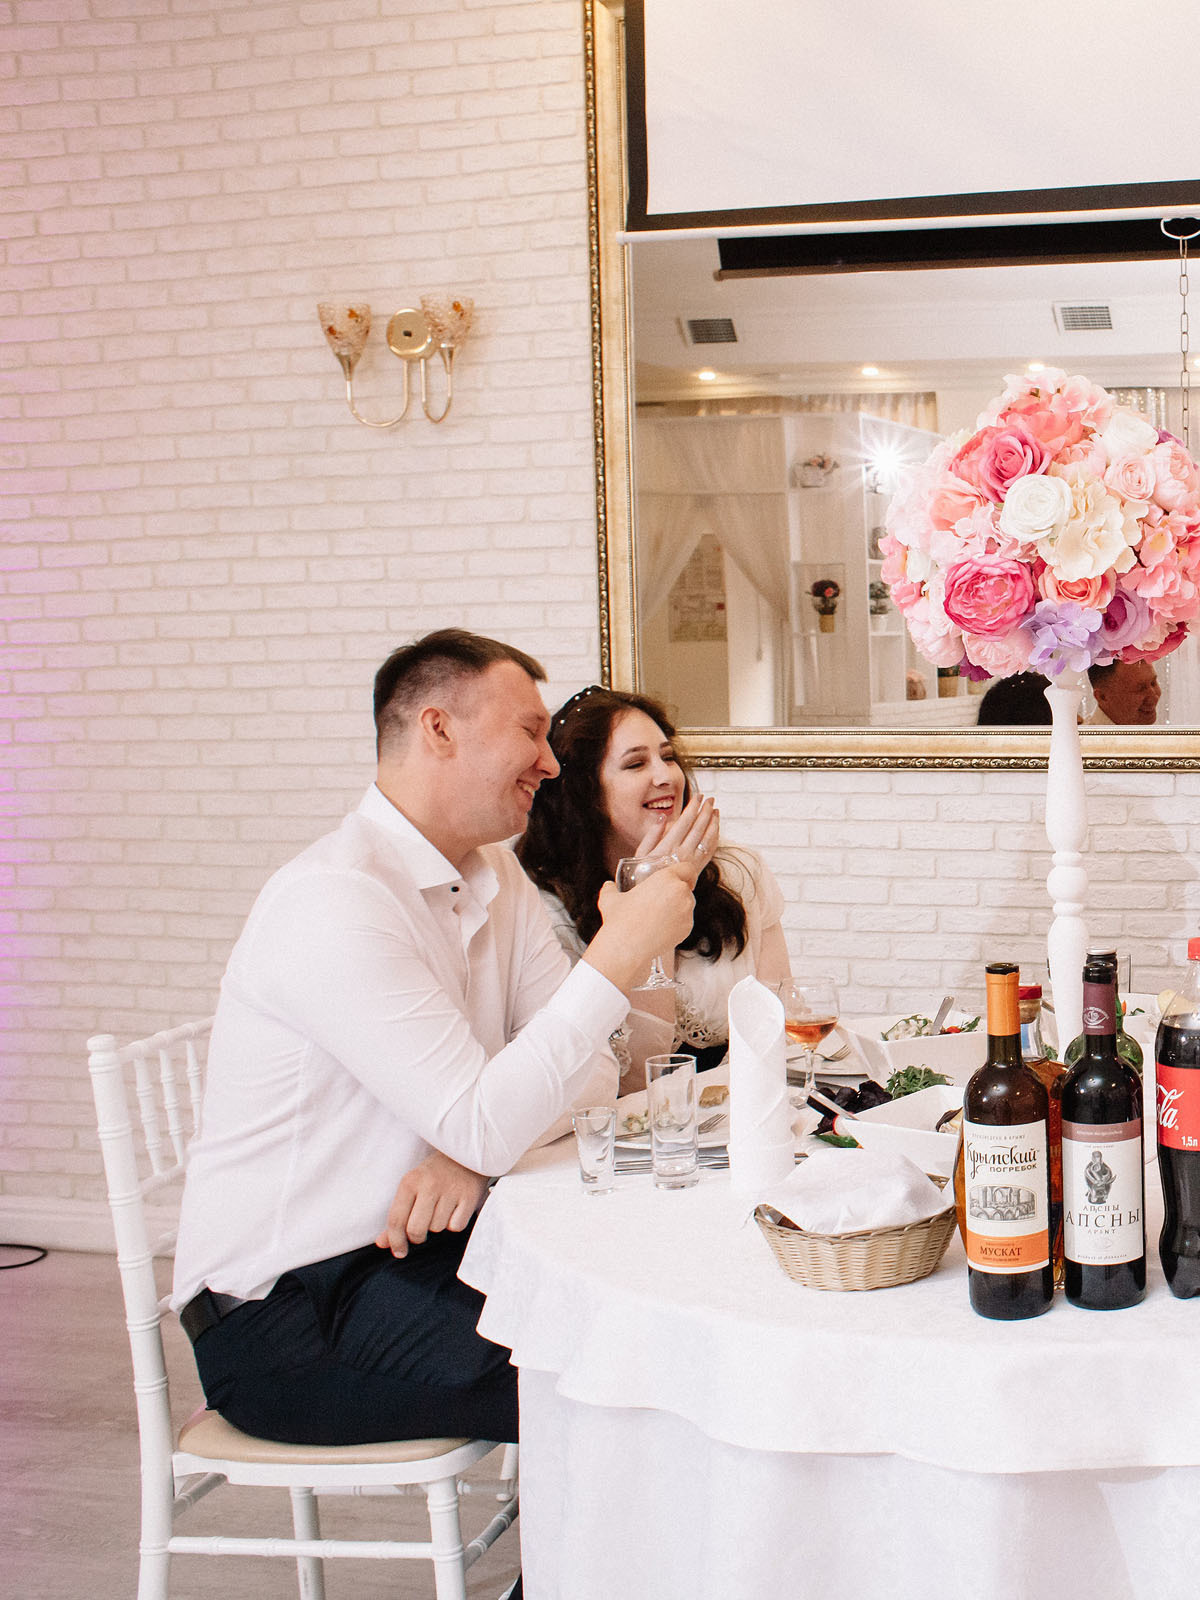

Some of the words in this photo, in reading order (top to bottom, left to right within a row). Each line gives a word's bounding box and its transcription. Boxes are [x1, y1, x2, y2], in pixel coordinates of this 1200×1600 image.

[1181, 1136, 1198, 1147] 1,5л
[966, 1140, 1038, 1179] Крымский
[989, 1164, 1037, 1173] ПОГРЕБОК
[1065, 1208, 1141, 1228] АПСНЫ
[980, 1246, 1022, 1257] МУСКАТ
